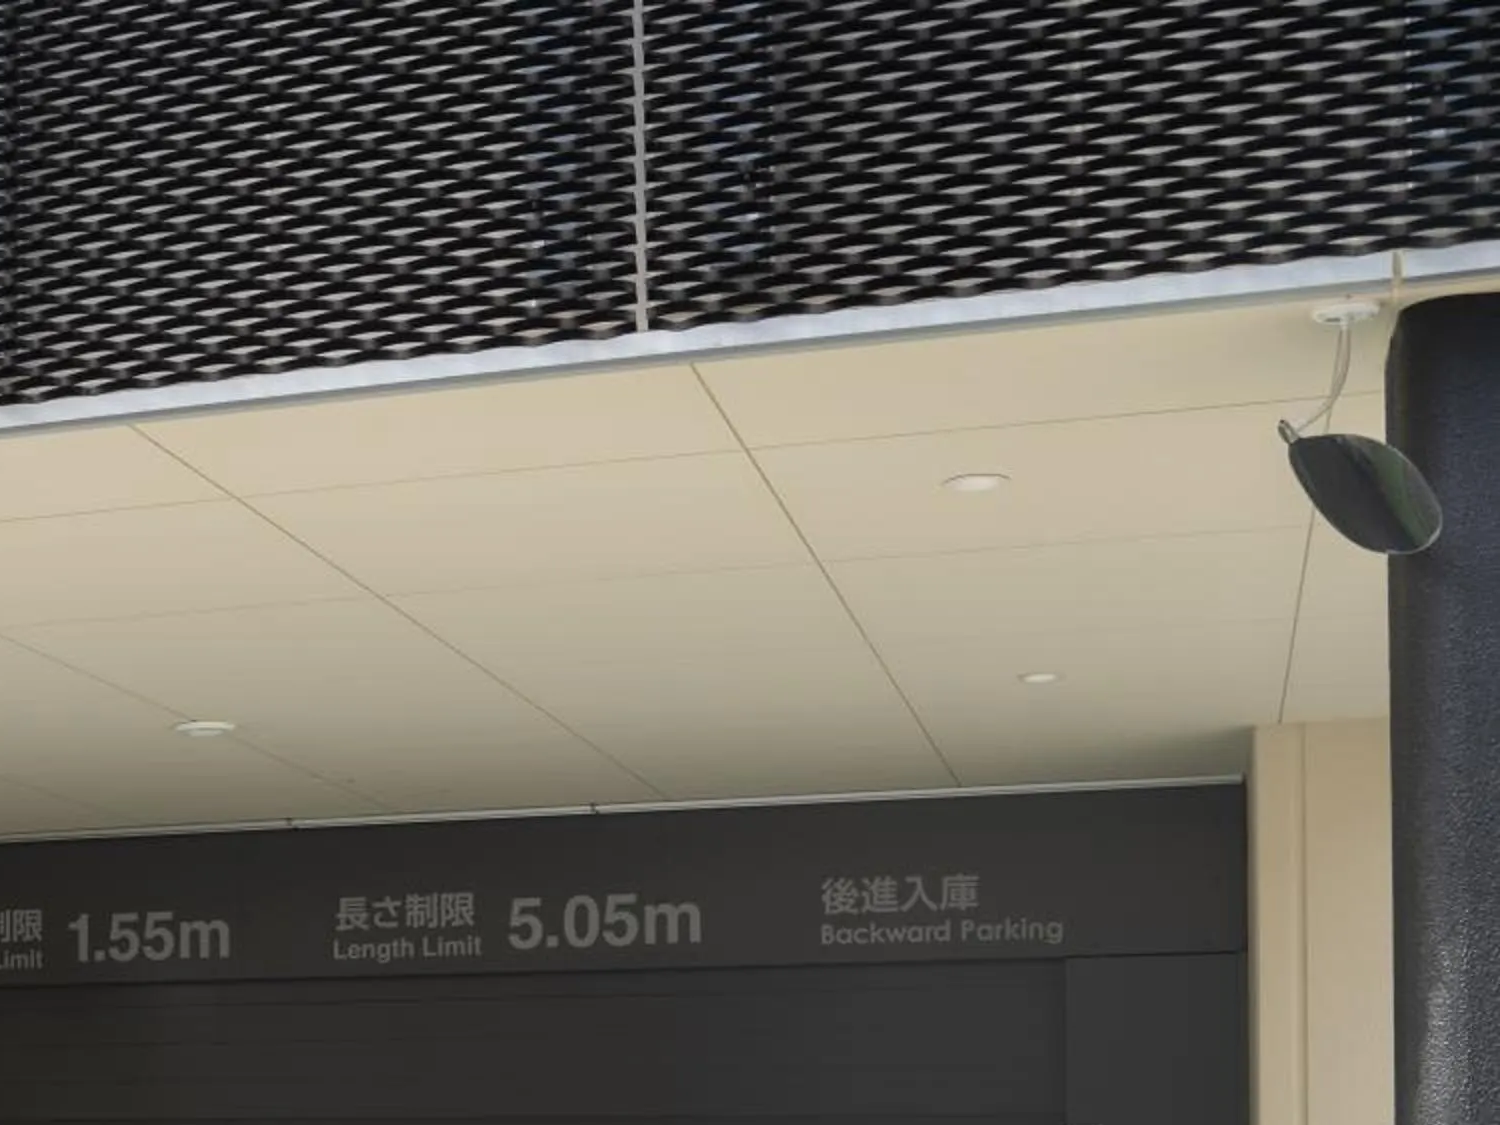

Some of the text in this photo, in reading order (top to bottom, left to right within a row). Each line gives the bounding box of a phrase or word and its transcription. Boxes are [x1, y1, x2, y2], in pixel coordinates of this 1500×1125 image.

[821, 873, 980, 915] 後進入庫
[68, 910, 230, 963] 1.55m
[335, 891, 702, 950] 長さ制限 5.05m
[820, 916, 1064, 945] Backward Parking
[333, 934, 482, 963] Length Limit
